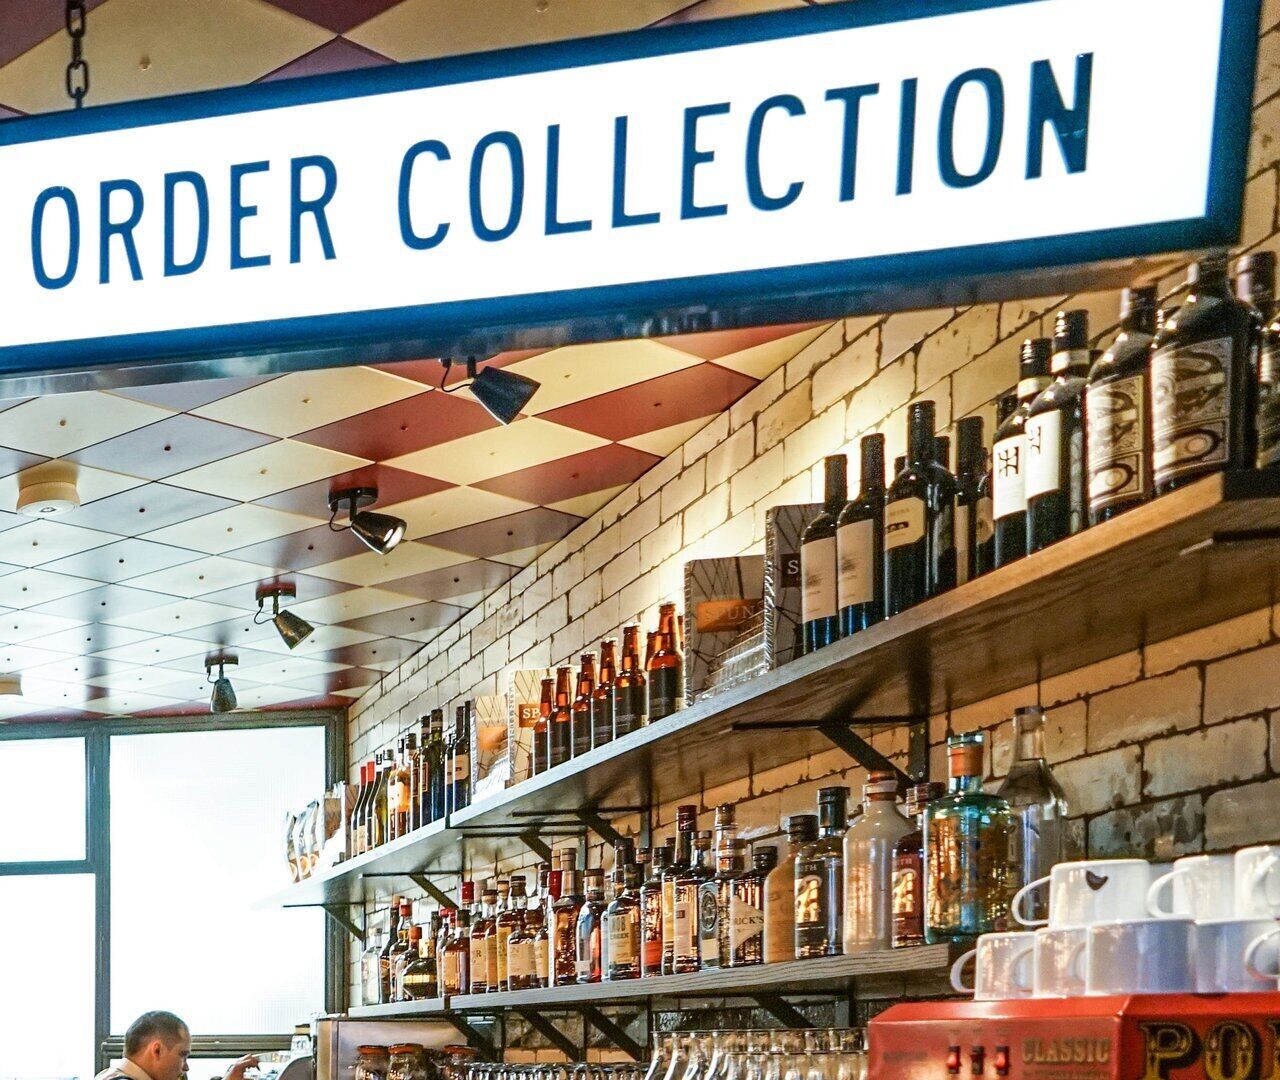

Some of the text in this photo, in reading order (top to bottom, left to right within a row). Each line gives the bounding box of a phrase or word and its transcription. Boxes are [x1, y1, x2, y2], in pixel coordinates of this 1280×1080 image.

[31, 51, 1095, 290] ORDER COLLECTION
[1021, 1036, 1111, 1065] CLASSIC
